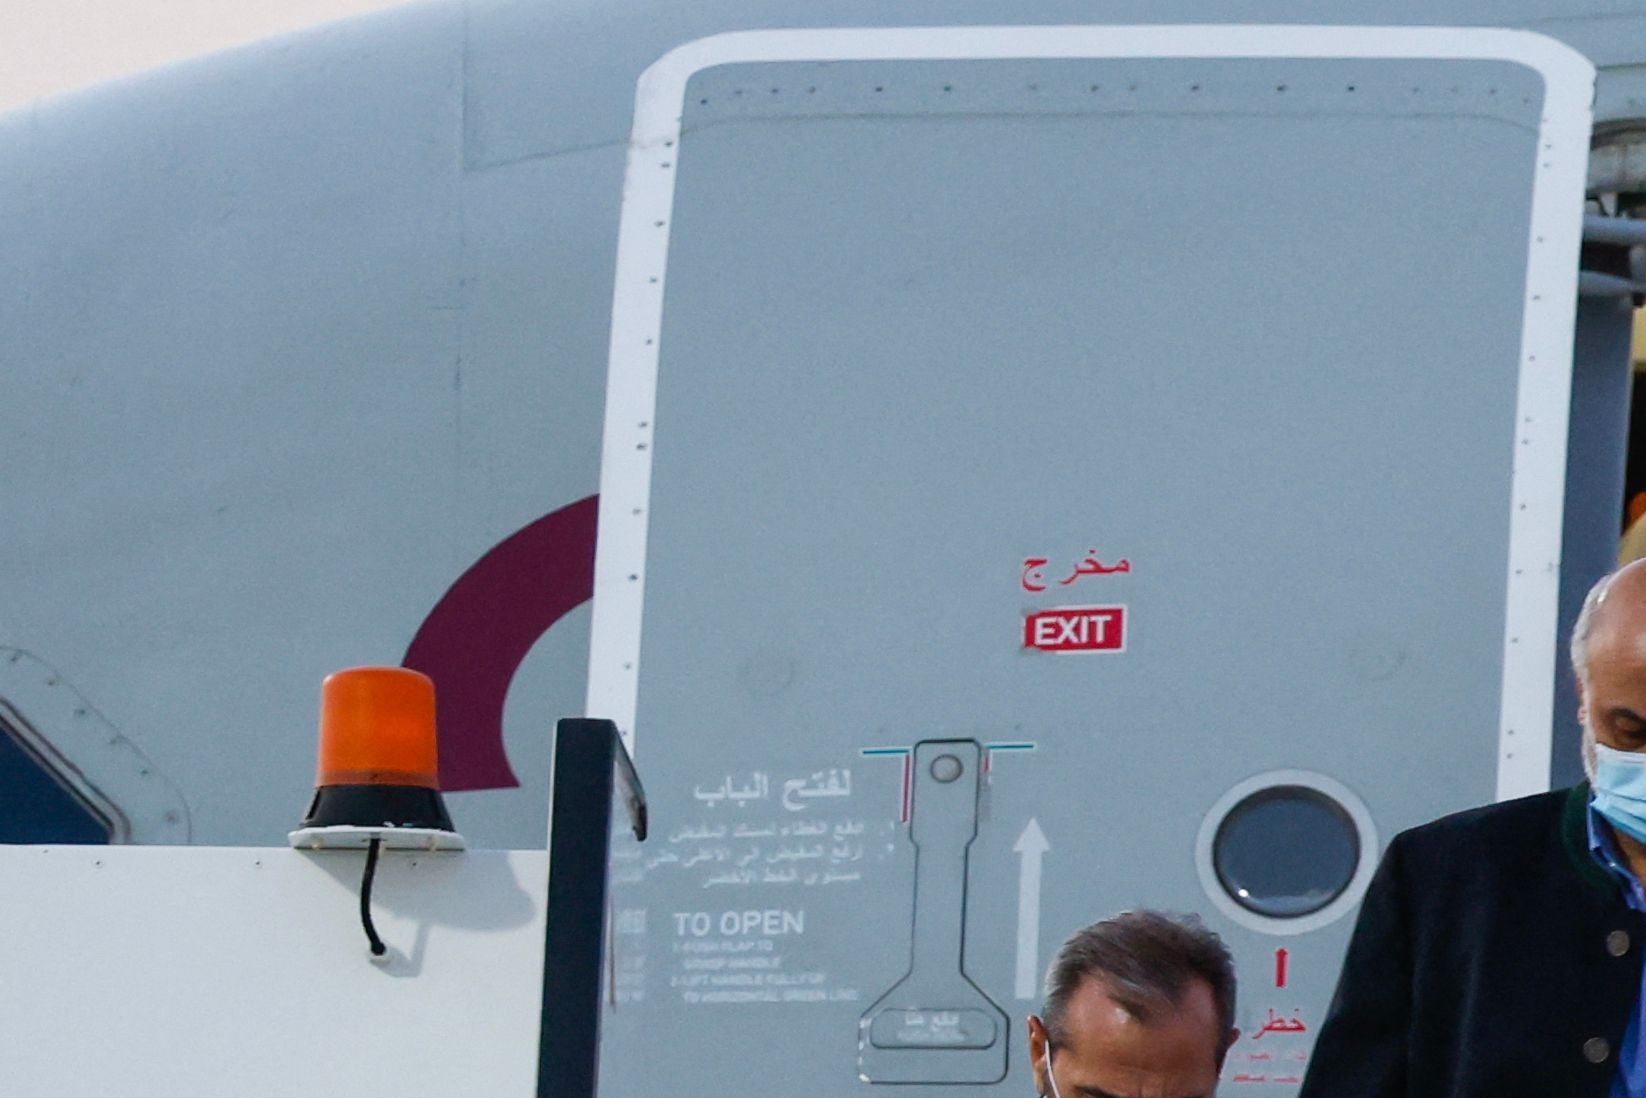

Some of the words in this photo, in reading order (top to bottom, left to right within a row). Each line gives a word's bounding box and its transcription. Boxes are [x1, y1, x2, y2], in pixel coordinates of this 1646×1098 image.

[1021, 549, 1131, 592] مخرج
[1034, 614, 1113, 646] EXIT
[694, 771, 769, 808] الباب
[673, 912, 711, 937] TO
[719, 909, 805, 936] OPEN
[1251, 1007, 1307, 1040] خطر
